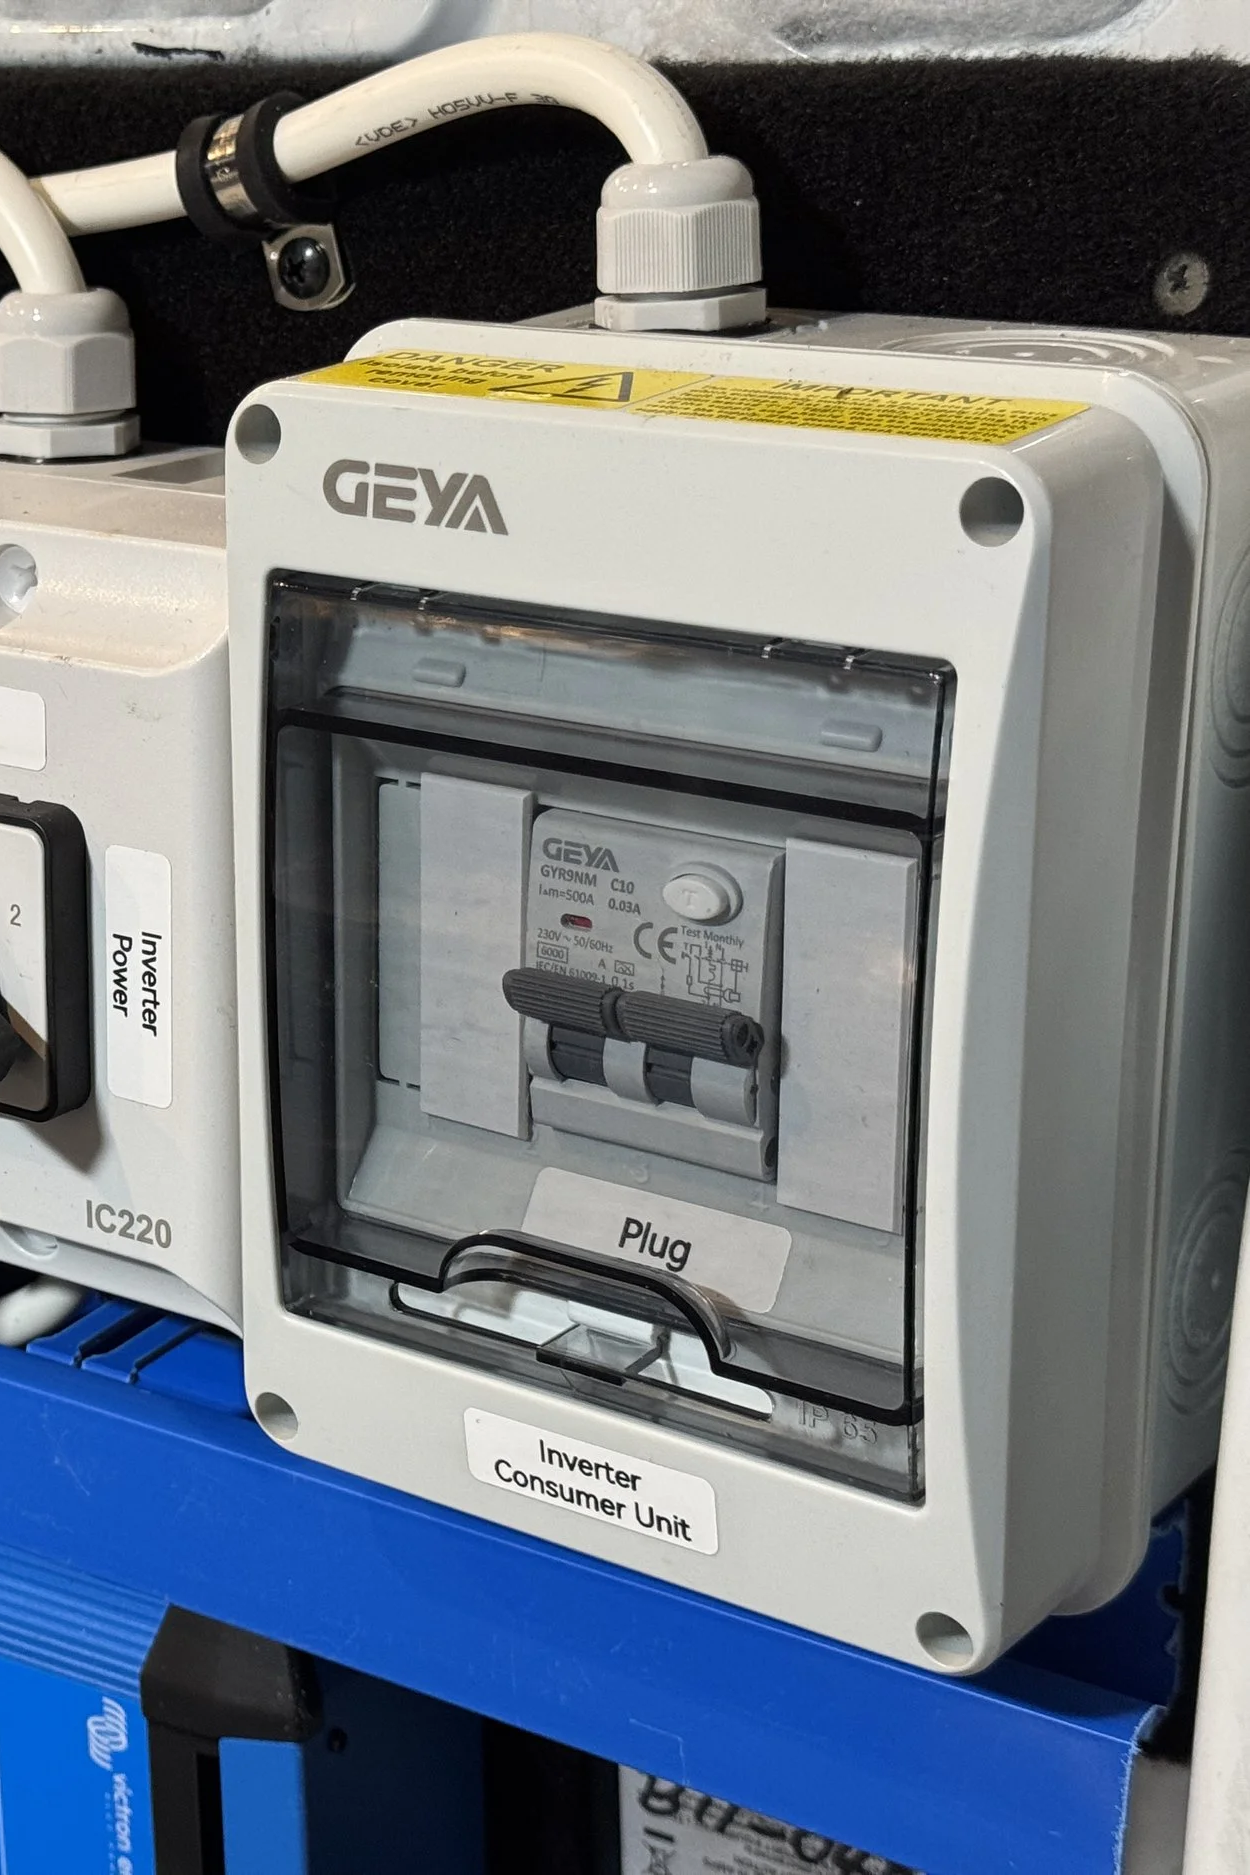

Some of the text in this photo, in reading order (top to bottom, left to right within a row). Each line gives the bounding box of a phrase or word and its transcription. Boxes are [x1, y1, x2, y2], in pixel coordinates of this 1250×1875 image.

[359, 359, 535, 380] Isolate before
[366, 368, 488, 385] removing
[385, 351, 565, 373] DANGER
[368, 376, 447, 389] cover
[772, 382, 1014, 405] IMPORTANT
[323, 458, 509, 536] GEYA
[542, 837, 620, 873] GEYA
[540, 864, 635, 895] GYR9NM C10
[10, 904, 22, 927] 2
[607, 898, 641, 915] 0.03A
[681, 925, 745, 950] Test Monthly
[112, 933, 133, 1018] Power
[141, 932, 163, 1037] Inverter
[86, 1199, 172, 1248] IC220
[618, 1216, 692, 1273] Plug
[539, 1439, 642, 1491] Inverter
[494, 1459, 693, 1542] Consumer Unit
[112, 1773, 134, 1854] victron
